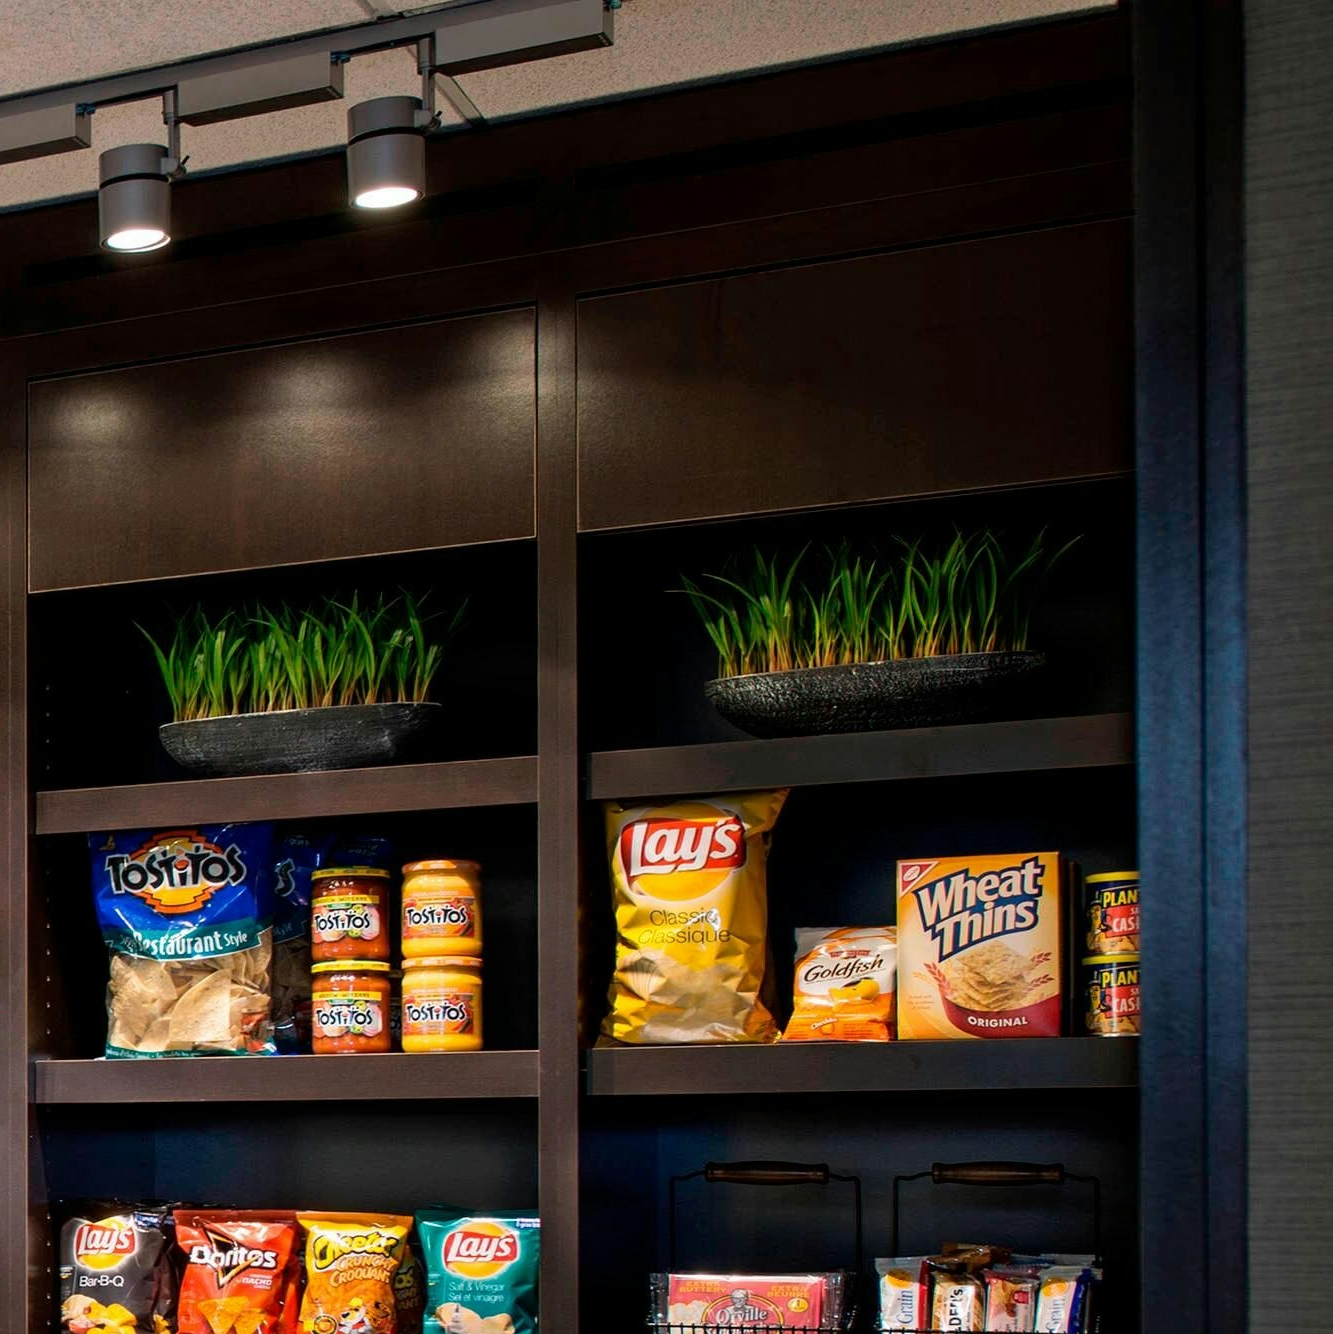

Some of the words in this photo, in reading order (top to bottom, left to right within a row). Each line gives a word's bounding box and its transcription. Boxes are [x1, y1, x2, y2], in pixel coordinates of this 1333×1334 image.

[630, 819, 741, 877] Lay's
[106, 844, 246, 894] TOSTITOS
[917, 860, 1042, 928] Wheat
[1102, 888, 1142, 908] PLAN
[224, 931, 248, 947] Style
[637, 927, 731, 946] Classique
[934, 901, 1035, 957] Thins
[803, 953, 885, 983] Goldfish
[1101, 970, 1142, 988] PLAN
[967, 1015, 1029, 1029] ORIGINAL
[77, 1224, 133, 1255] Lay's
[446, 1231, 516, 1263] Lay's
[189, 1244, 278, 1269] Doritos
[336, 1255, 398, 1271] CRUNCHY
[475, 1281, 505, 1293] Vinegar
[715, 1308, 768, 1325] Orville
[898, 1290, 913, 1324] Grain
